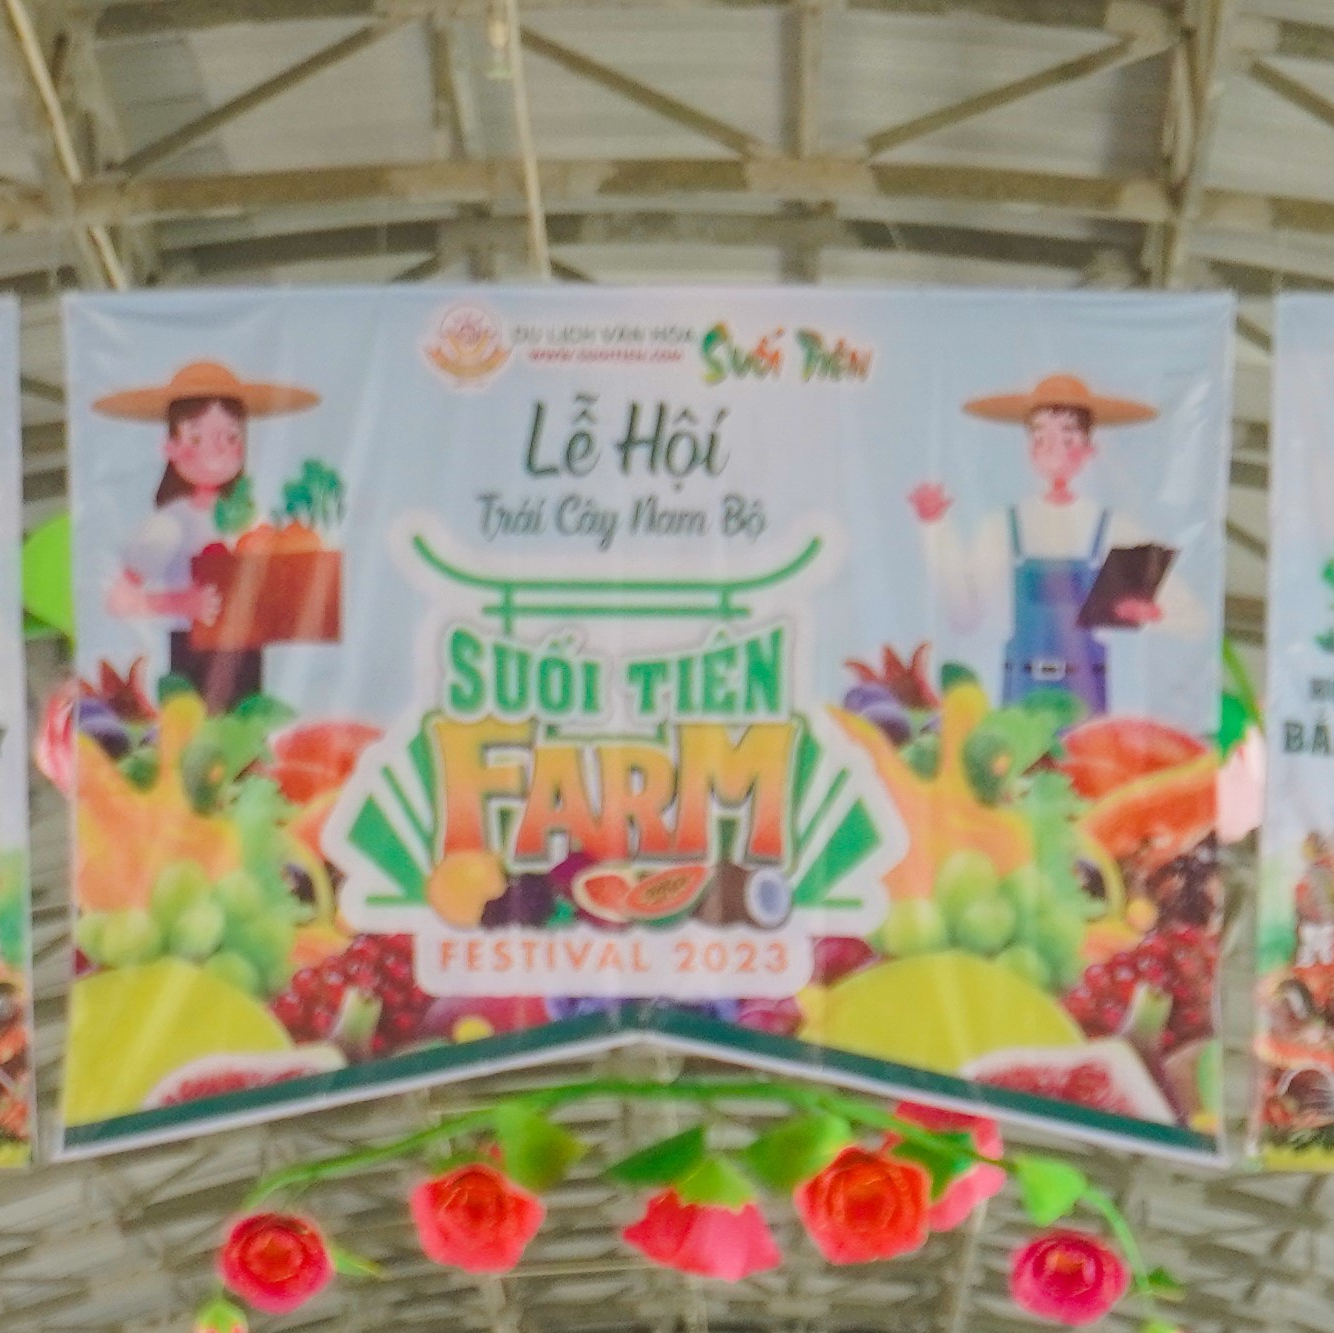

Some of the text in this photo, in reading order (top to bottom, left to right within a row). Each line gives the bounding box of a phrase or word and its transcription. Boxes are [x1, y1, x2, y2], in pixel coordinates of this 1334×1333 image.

[525, 392, 731, 491] Lễ Hội
[477, 492, 768, 552] Trái Cây Nam Bộ
[446, 619, 786, 716] SUỐI TIÊN
[430, 716, 801, 863] FARM
[438, 940, 790, 973] FESTIVAL 2023
